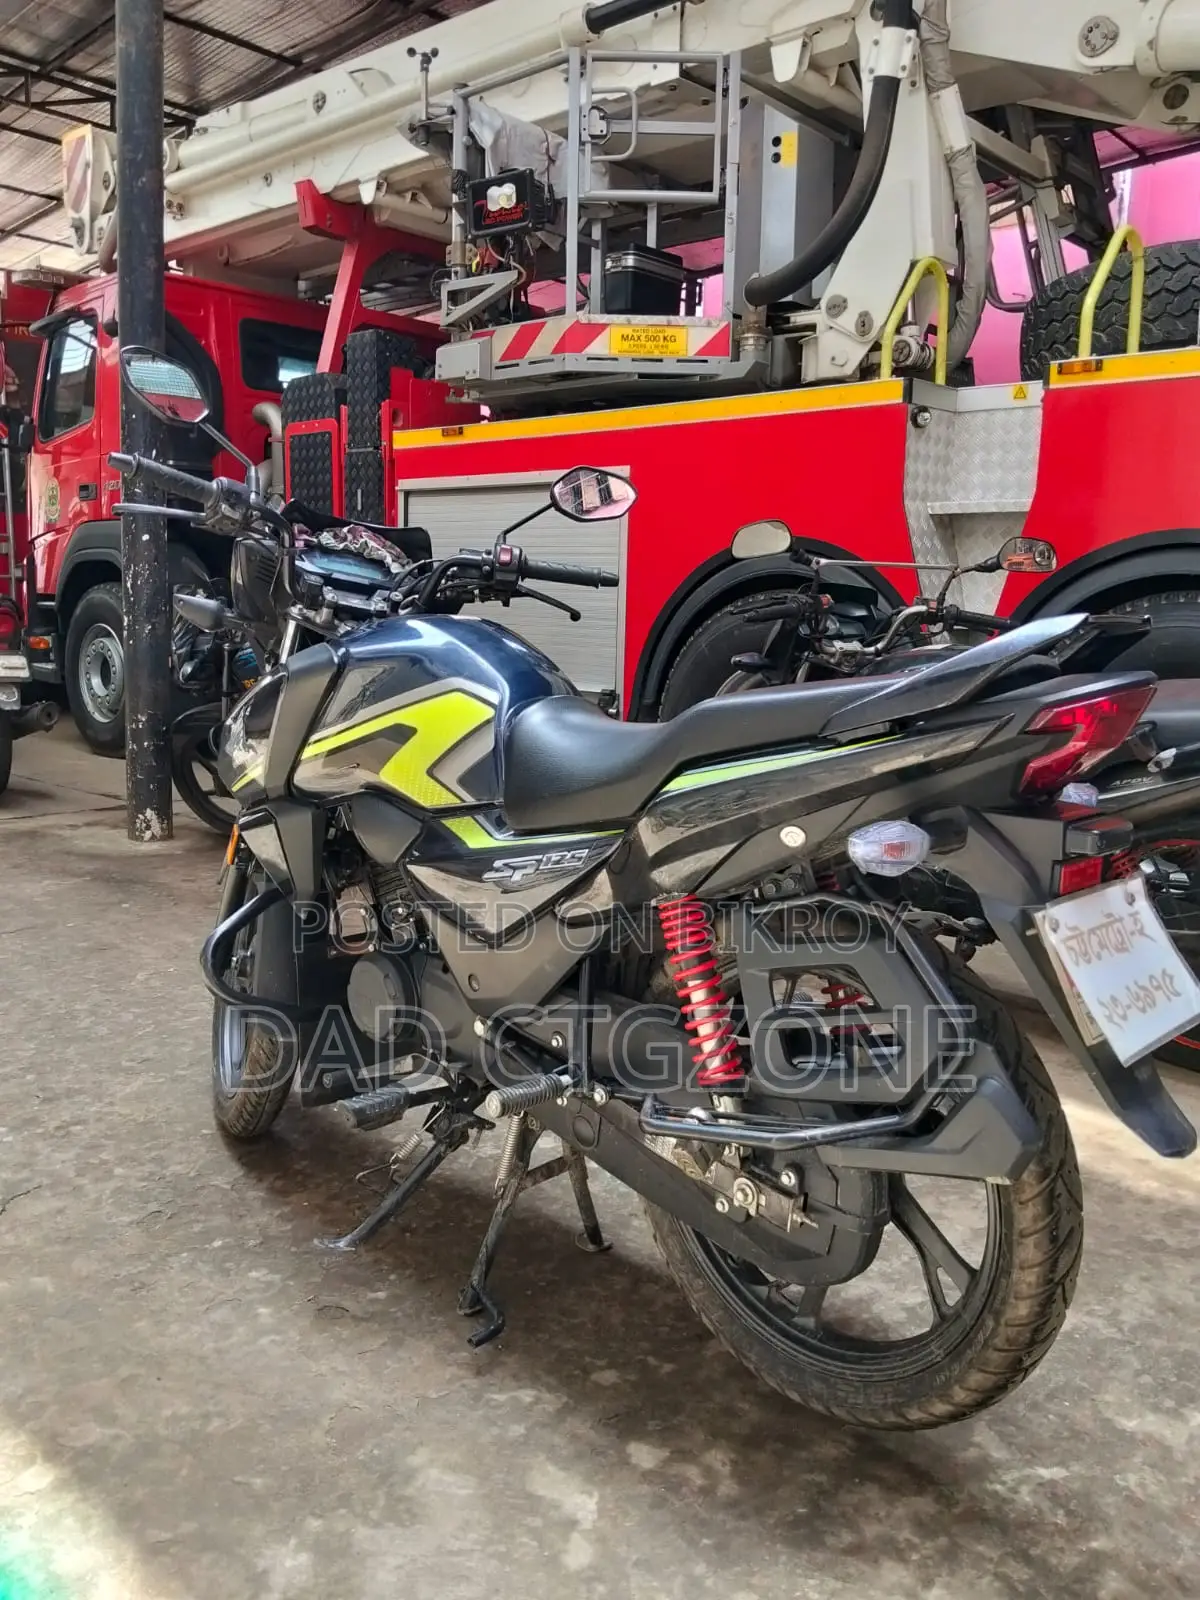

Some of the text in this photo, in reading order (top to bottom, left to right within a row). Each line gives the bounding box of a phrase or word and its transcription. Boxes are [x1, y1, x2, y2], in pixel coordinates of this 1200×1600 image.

[621, 333, 677, 344] MAX 500 KG
[482, 848, 589, 882] SP 125
